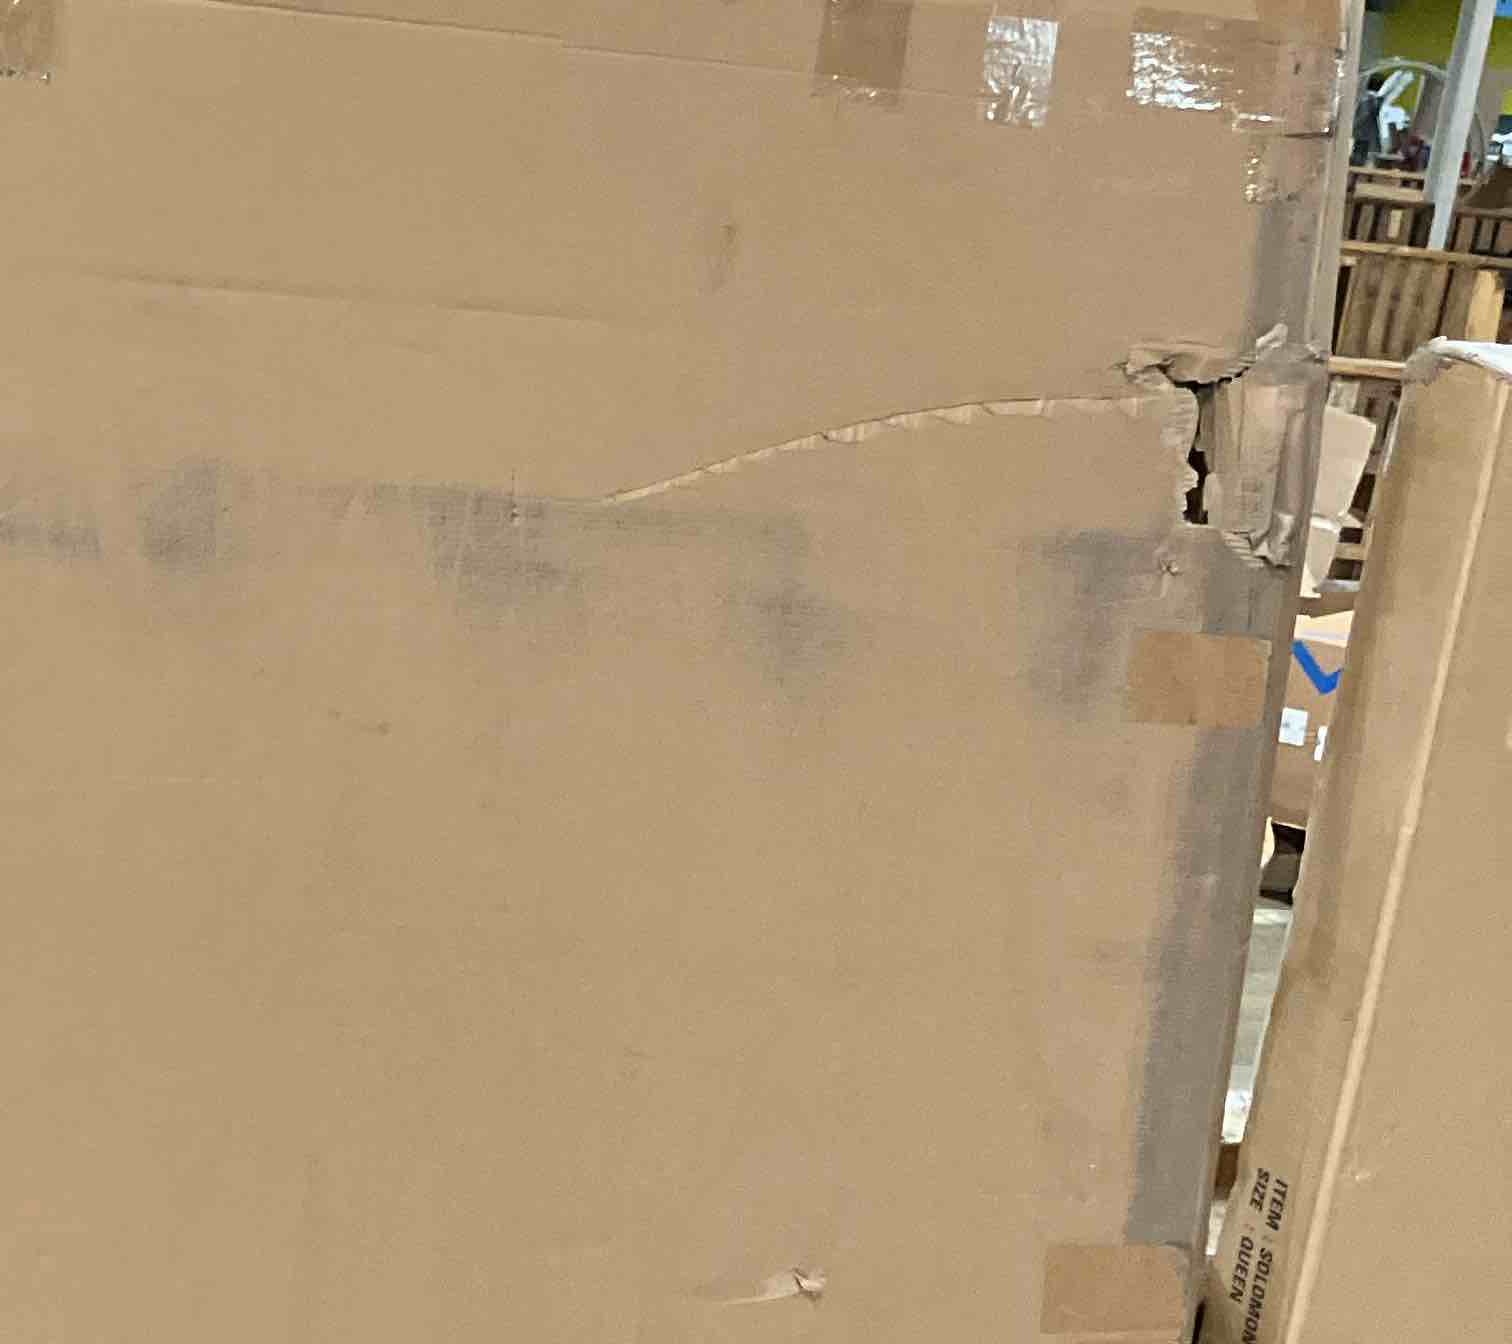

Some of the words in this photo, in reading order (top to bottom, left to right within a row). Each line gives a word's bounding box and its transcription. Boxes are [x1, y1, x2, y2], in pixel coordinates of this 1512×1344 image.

[1249, 1167, 1271, 1214] SIZE
[1265, 1178, 1289, 1232] ITEM
[1229, 1235, 1255, 1306] QUEEN
